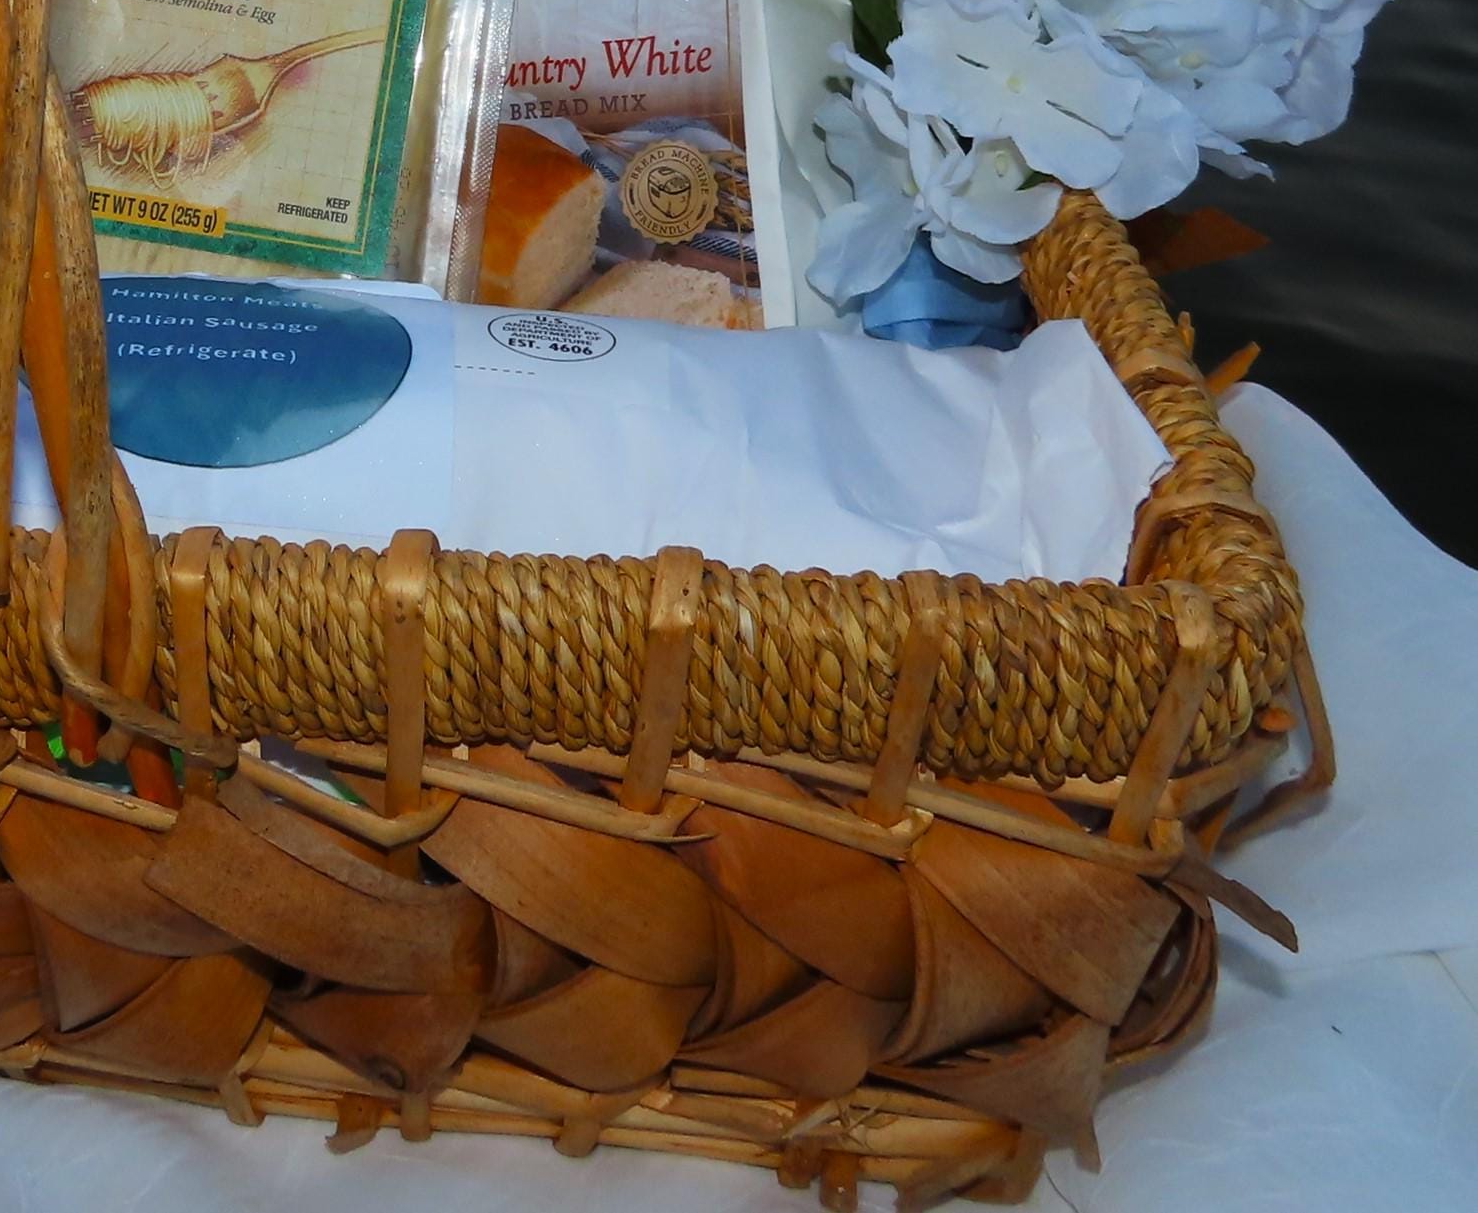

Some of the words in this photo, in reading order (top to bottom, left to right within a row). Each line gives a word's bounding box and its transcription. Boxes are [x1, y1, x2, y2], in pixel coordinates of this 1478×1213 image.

[236, 3, 248, 16] &
[251, 6, 277, 25] Egg
[505, 55, 587, 91] untry
[602, 36, 713, 78] White
[510, 98, 589, 121] BREAD
[599, 94, 647, 114] MIX
[631, 150, 665, 180] BREAD
[671, 149, 710, 195] MACHINE
[277, 202, 348, 224] REFRIGERATED
[326, 197, 351, 210] KEEP
[113, 197, 136, 215] WT
[138, 202, 147, 218] 9
[149, 204, 169, 222] OZ
[172, 204, 202, 228] (255
[204, 210, 218, 233] g)
[635, 209, 690, 235] FRIENDLY
[112, 288, 234, 302] Hamilton
[106, 312, 195, 326] Italian
[205, 317, 318, 334] Sausage
[502, 326, 584, 339] DEPARTMENT
[508, 338, 541, 350] EST.
[548, 343, 593, 356] 4606
[510, 332, 592, 346] AGRICULTURE
[117, 343, 297, 365] (Refrigerate)
